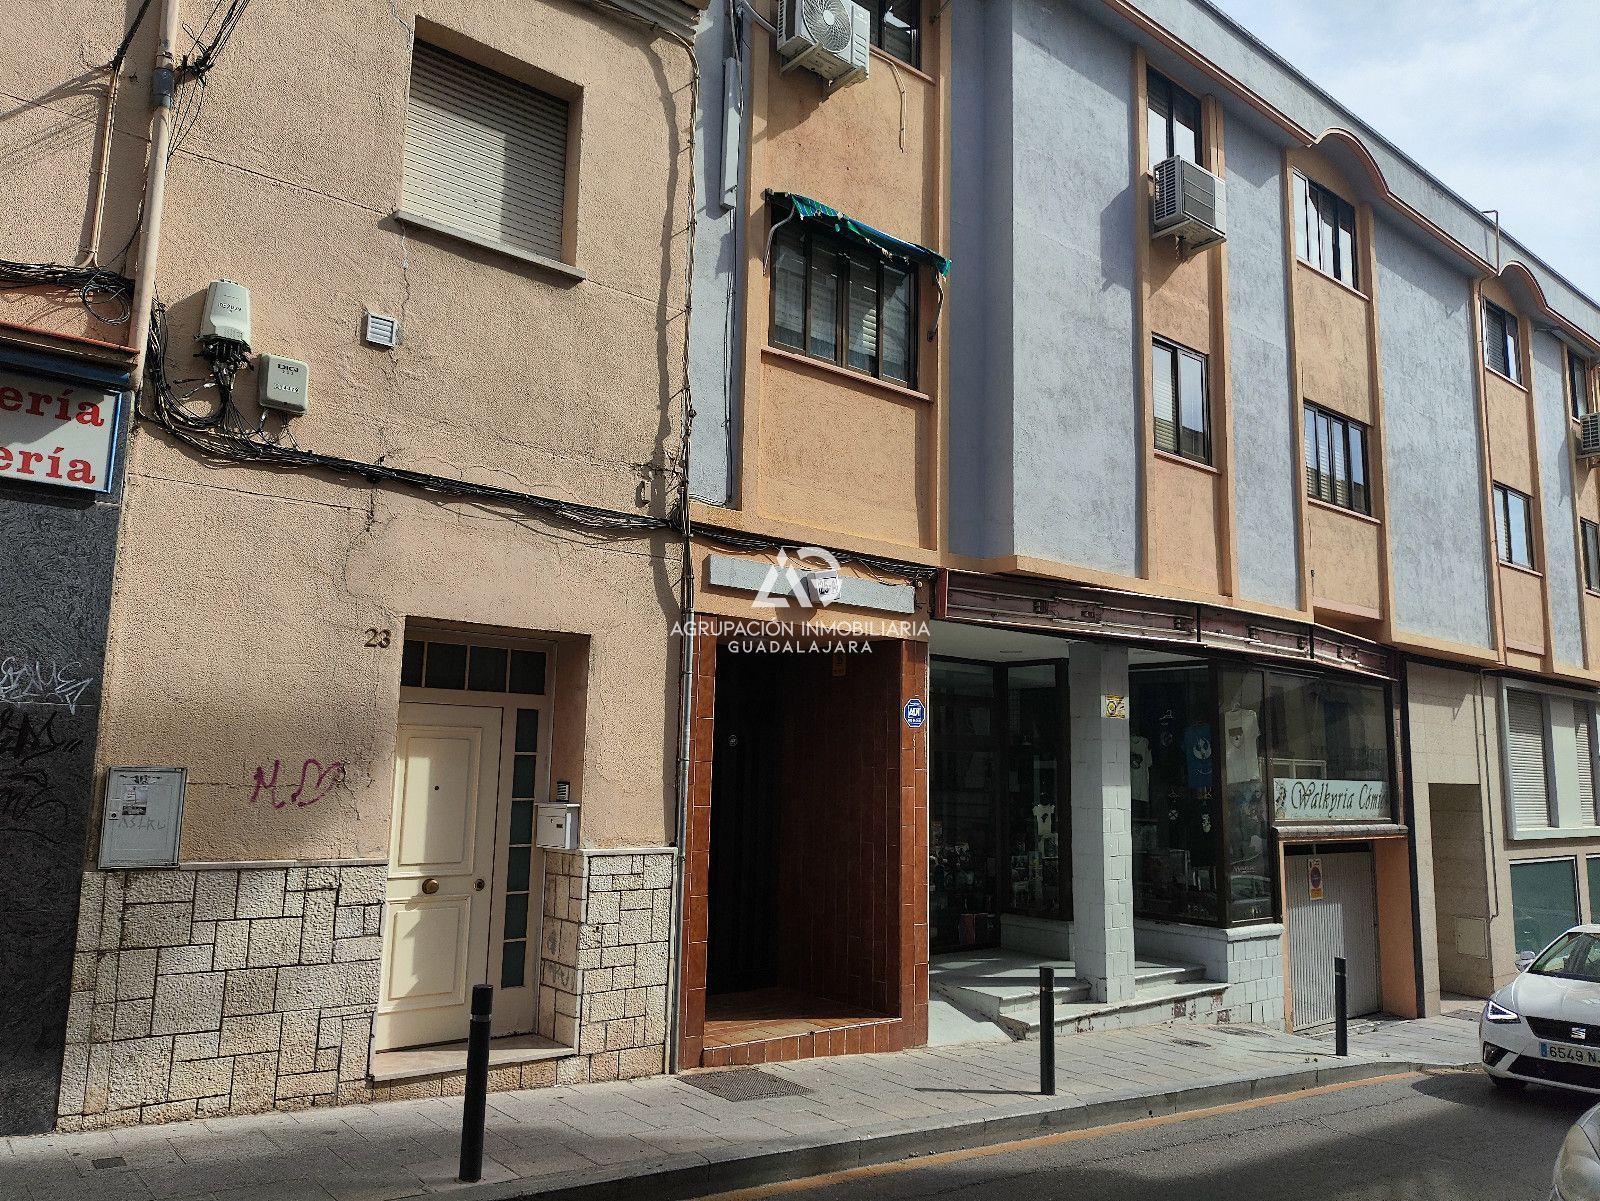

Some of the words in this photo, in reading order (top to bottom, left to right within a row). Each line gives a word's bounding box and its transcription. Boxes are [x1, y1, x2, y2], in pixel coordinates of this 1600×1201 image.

[364, 628, 391, 649] 23
[1291, 781, 1355, 818] Walkyria
[1550, 1046, 1584, 1062] 6549
